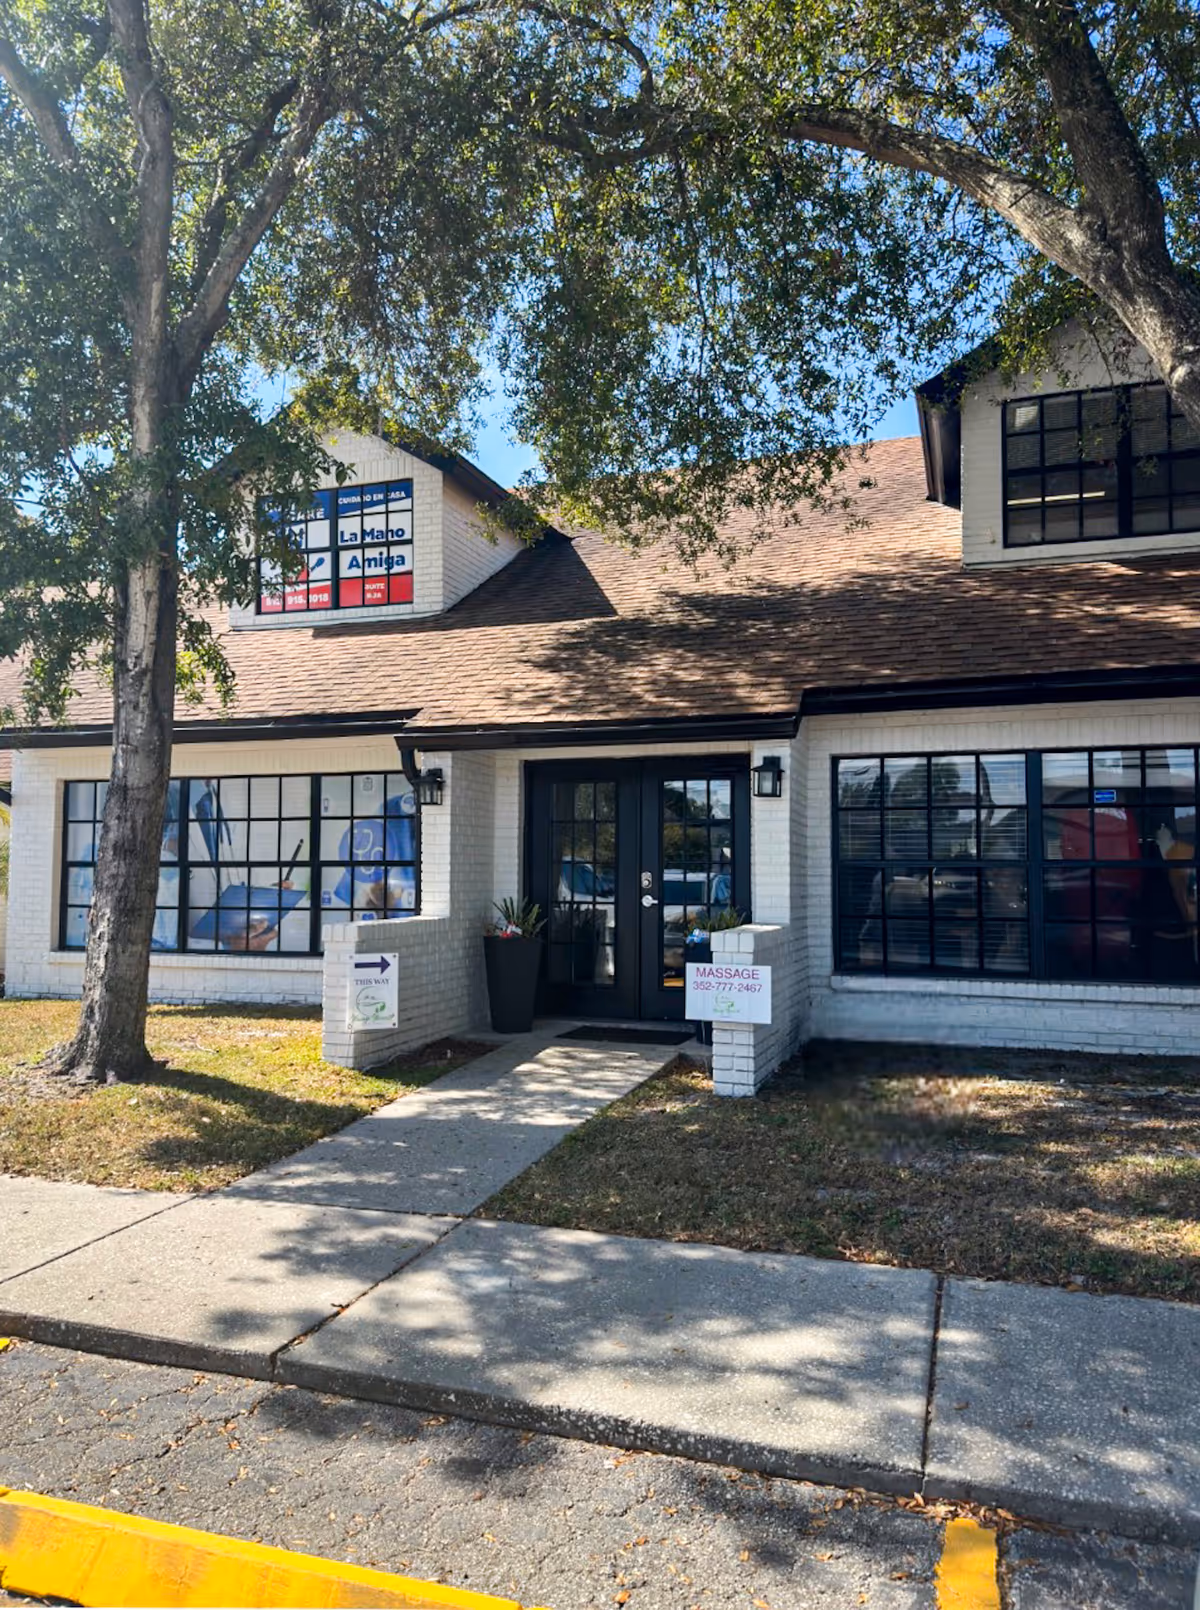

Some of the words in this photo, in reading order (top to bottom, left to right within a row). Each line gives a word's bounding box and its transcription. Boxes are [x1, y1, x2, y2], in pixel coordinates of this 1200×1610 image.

[373, 493, 384, 501] EN
[340, 530, 358, 543] La
[362, 528, 405, 542] Mano
[347, 552, 405, 570] Amiga
[696, 967, 760, 980] MASSAGE
[355, 978, 373, 986] THIS
[693, 981, 763, 993] 352-777-2467
